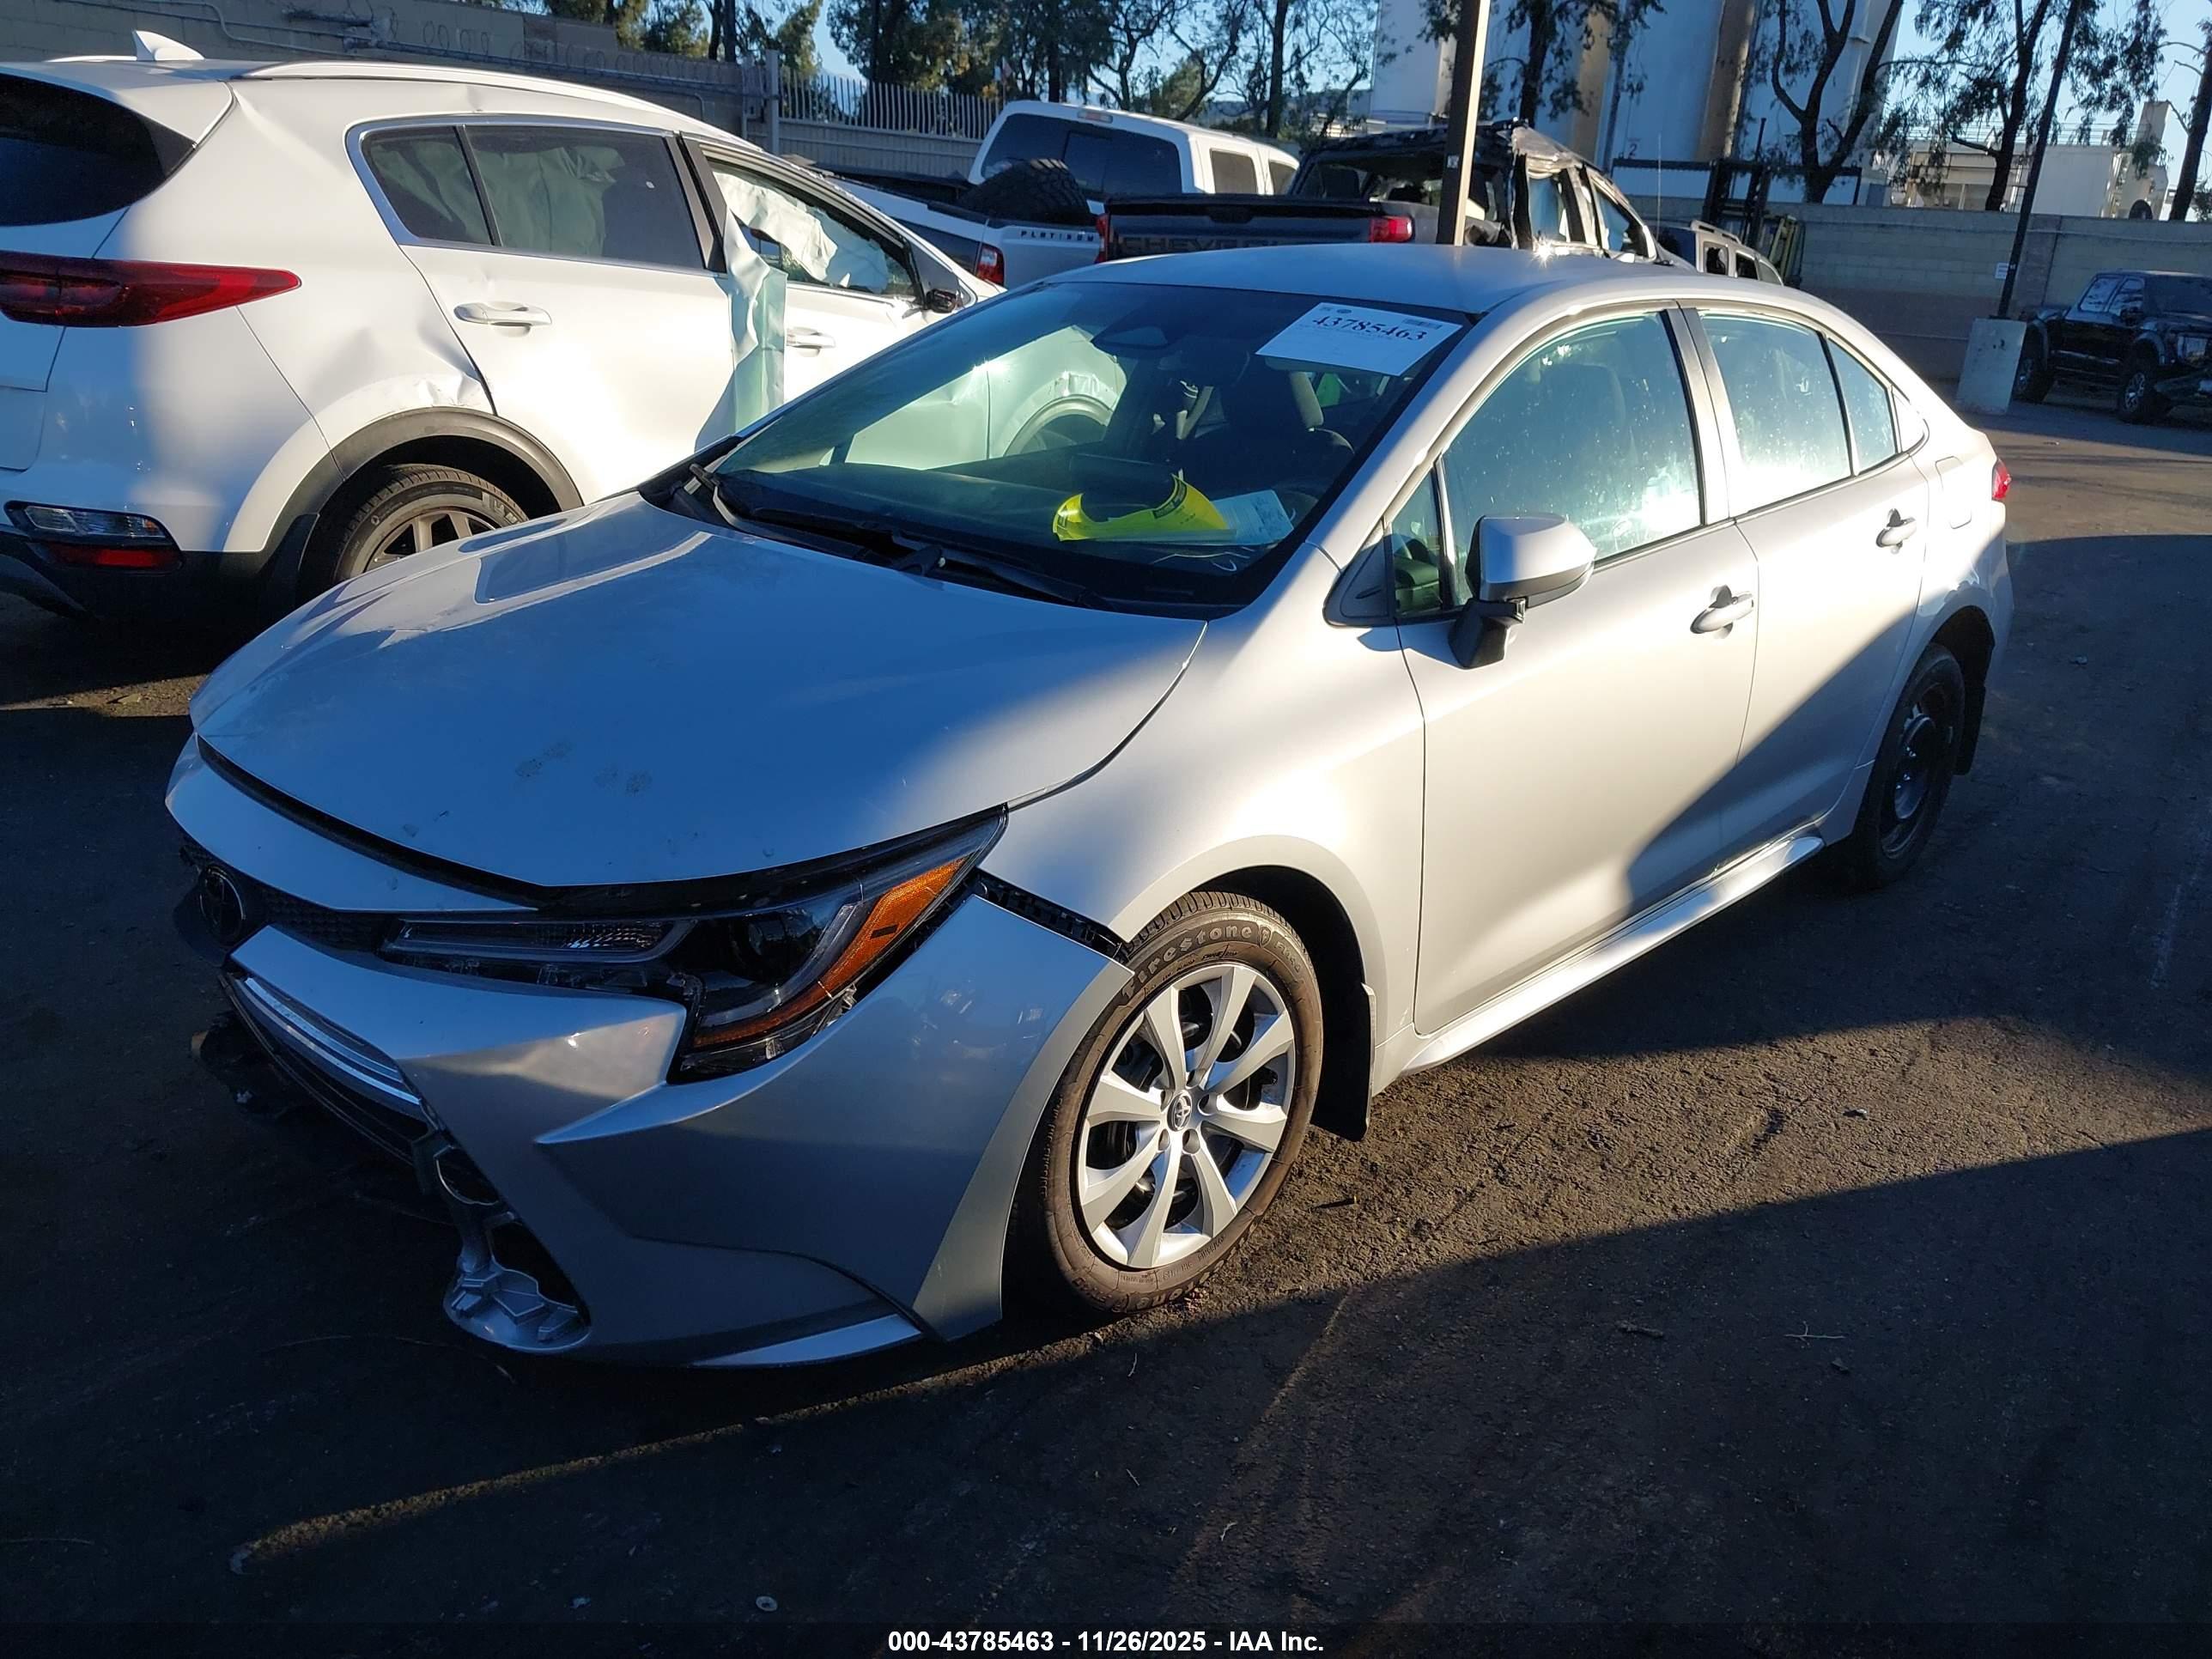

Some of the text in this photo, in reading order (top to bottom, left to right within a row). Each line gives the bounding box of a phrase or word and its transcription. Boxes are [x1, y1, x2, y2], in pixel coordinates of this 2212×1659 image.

[1020, 230, 1095, 242] PLATINUM
[1311, 315, 1428, 341] 43785463
[1121, 924, 1253, 1000] Firestone
